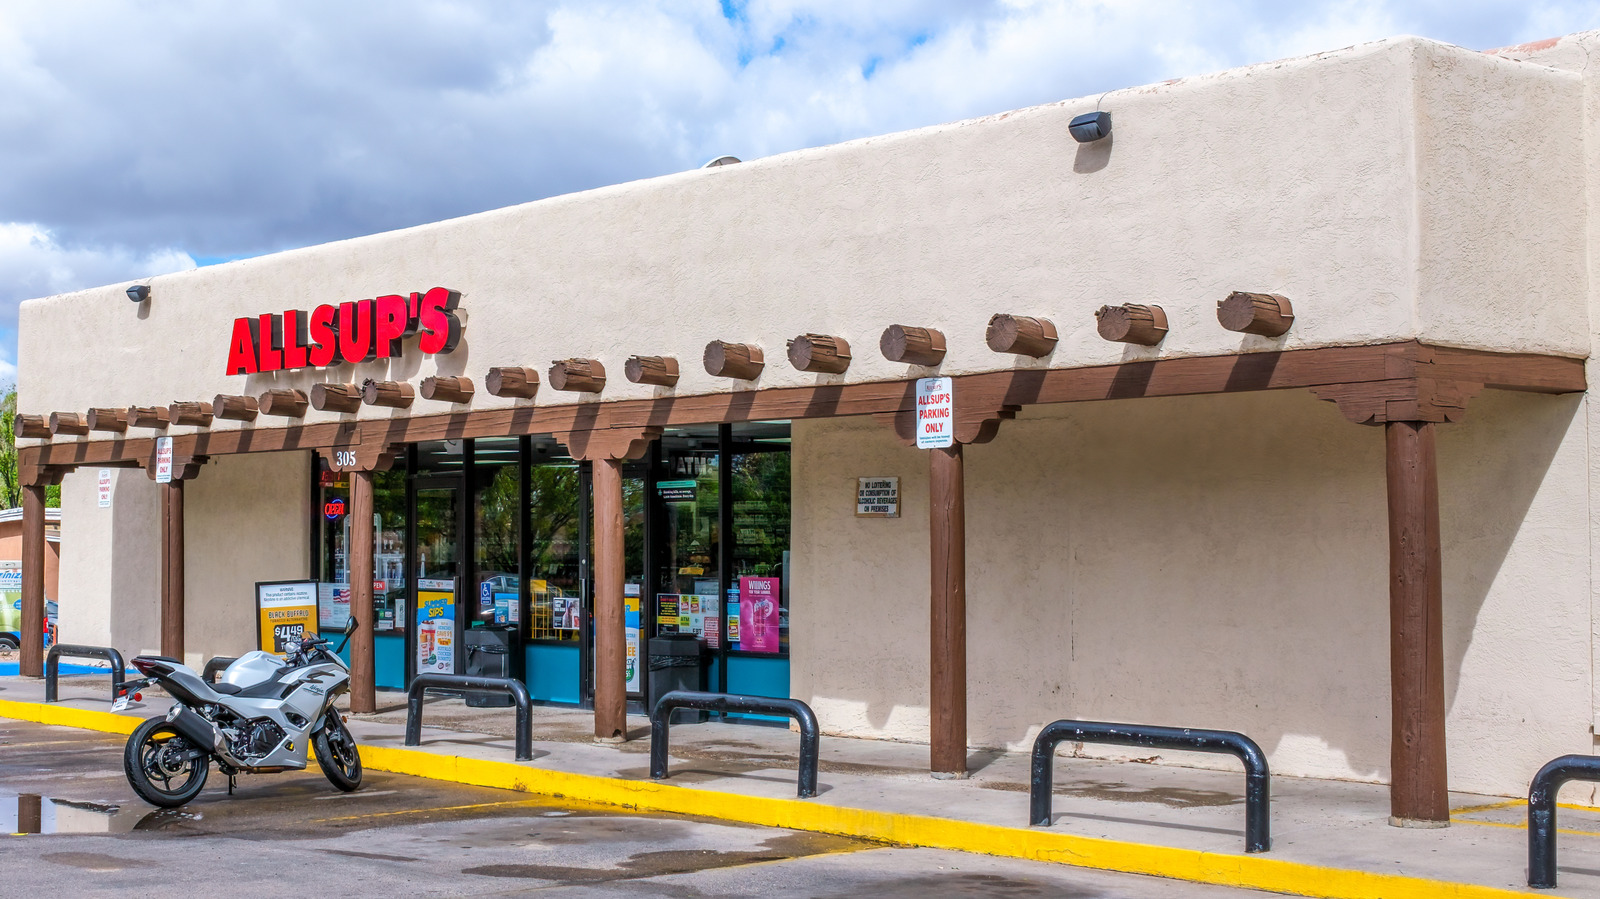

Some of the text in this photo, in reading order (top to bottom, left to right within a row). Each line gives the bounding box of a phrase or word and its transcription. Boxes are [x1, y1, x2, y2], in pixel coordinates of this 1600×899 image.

[226, 287, 456, 376] ALLSUP'S
[918, 393, 950, 406] ALLSUP'S
[919, 408, 950, 420] PARKING
[926, 422, 944, 433] ONLY
[336, 450, 356, 466] 305
[325, 503, 344, 514] OPEN
[428, 607, 444, 618] SIPS
